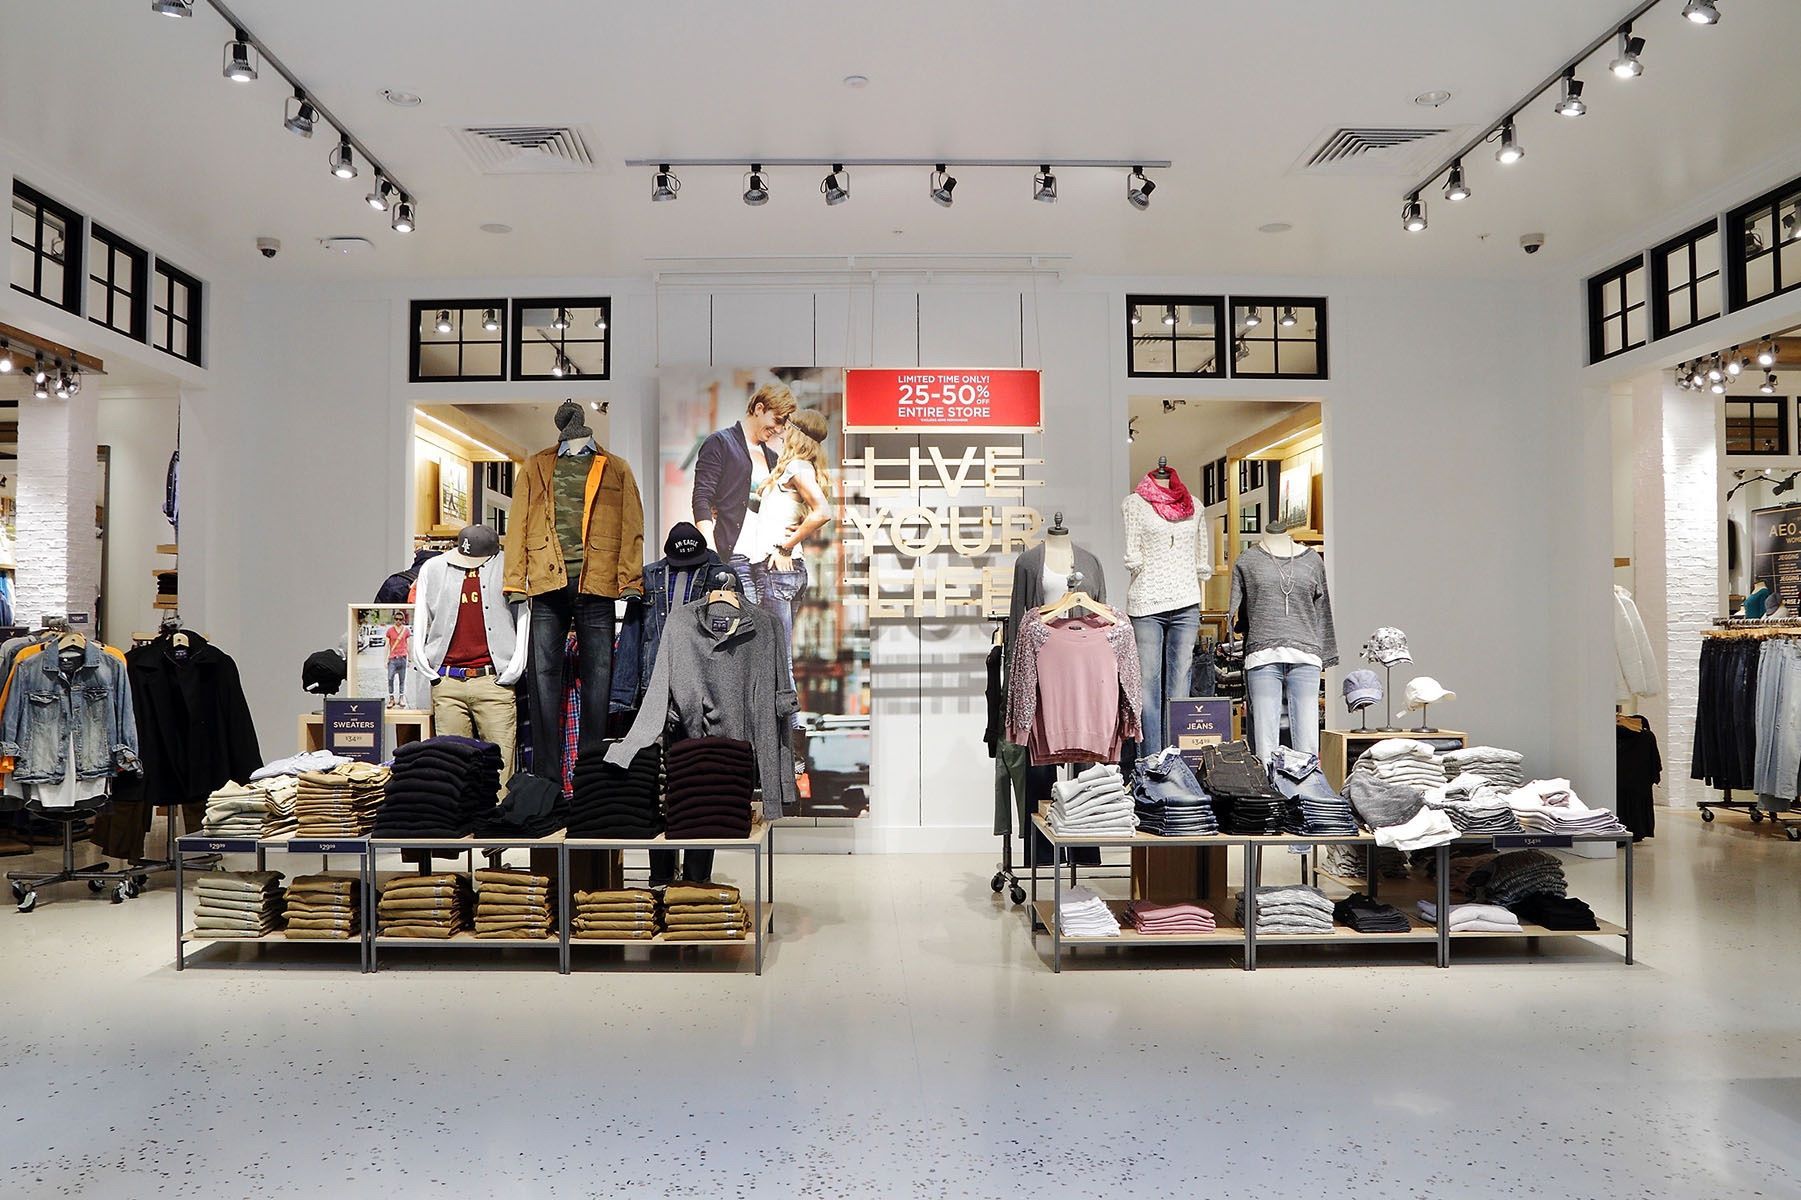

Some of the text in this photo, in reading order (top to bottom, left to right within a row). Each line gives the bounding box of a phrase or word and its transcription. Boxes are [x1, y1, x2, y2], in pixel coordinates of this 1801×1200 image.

[898, 375, 990, 384] LIMITED TIME ONLY!
[898, 406, 991, 418] ENTIRE STORE
[864, 446, 1023, 498] LIVE
[844, 506, 1043, 557] YOUR
[1769, 523, 1796, 537] AEO
[868, 566, 1015, 618] LIFE
[333, 721, 375, 729] SWEATERS
[1186, 722, 1214, 730] JEANS
